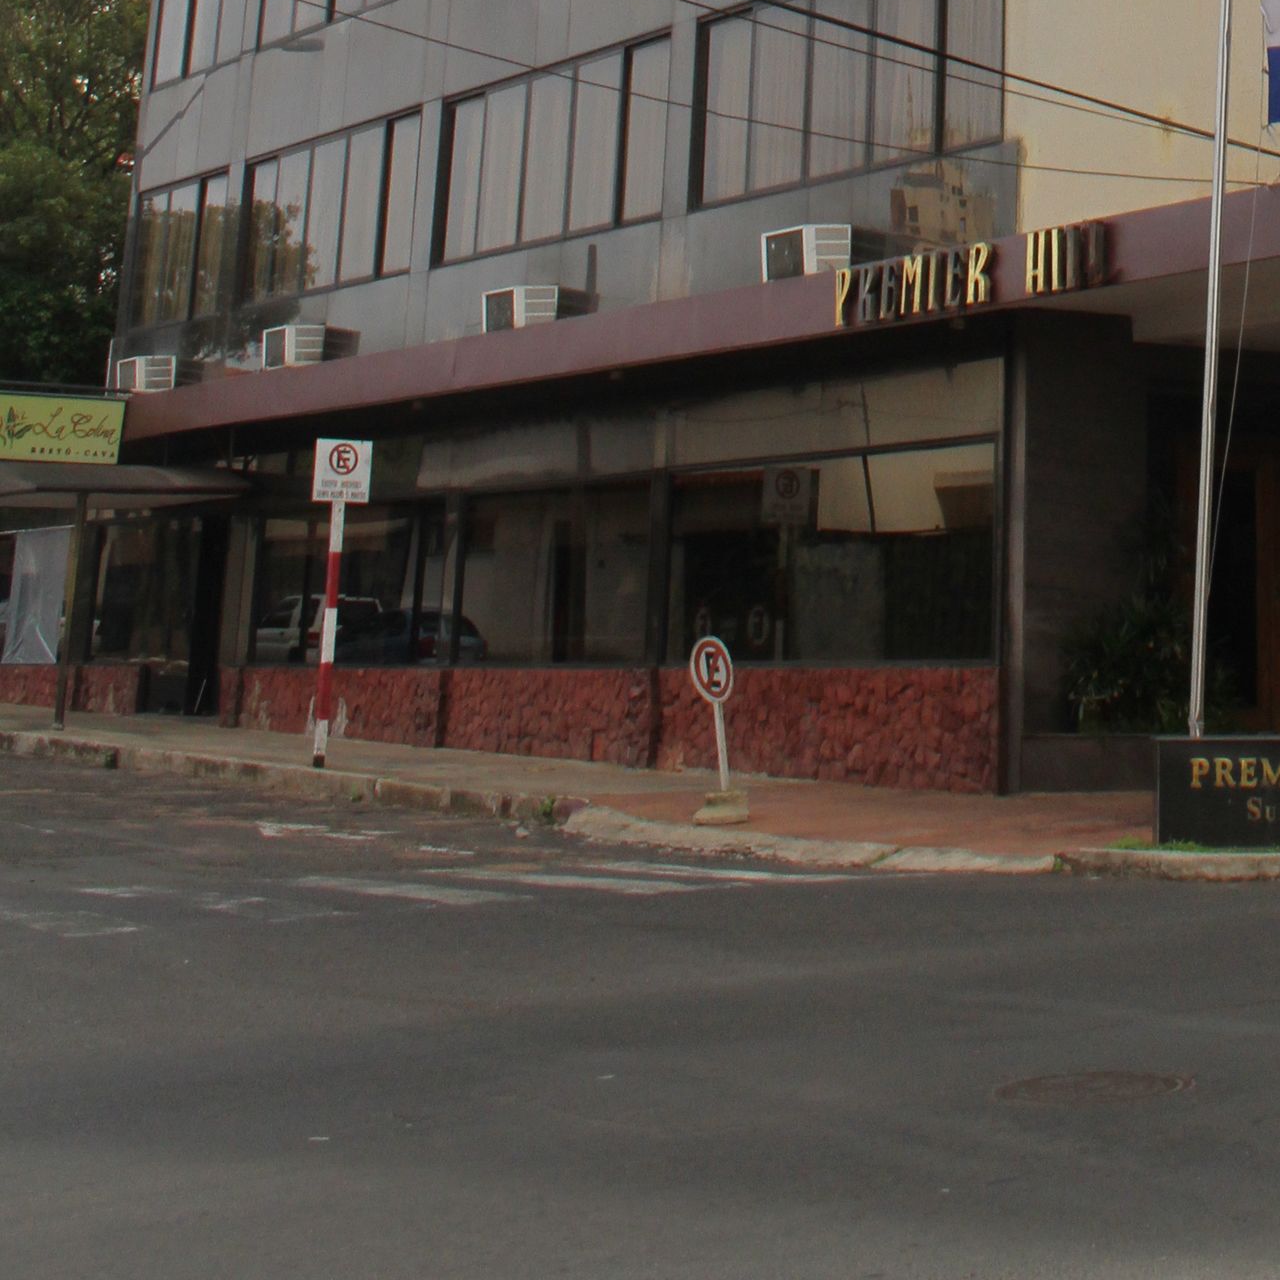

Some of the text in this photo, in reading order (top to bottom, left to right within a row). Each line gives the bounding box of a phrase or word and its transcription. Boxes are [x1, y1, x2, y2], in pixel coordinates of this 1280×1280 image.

[835, 221, 1110, 329] PREMIER HILL
[33, 406, 65, 441] La
